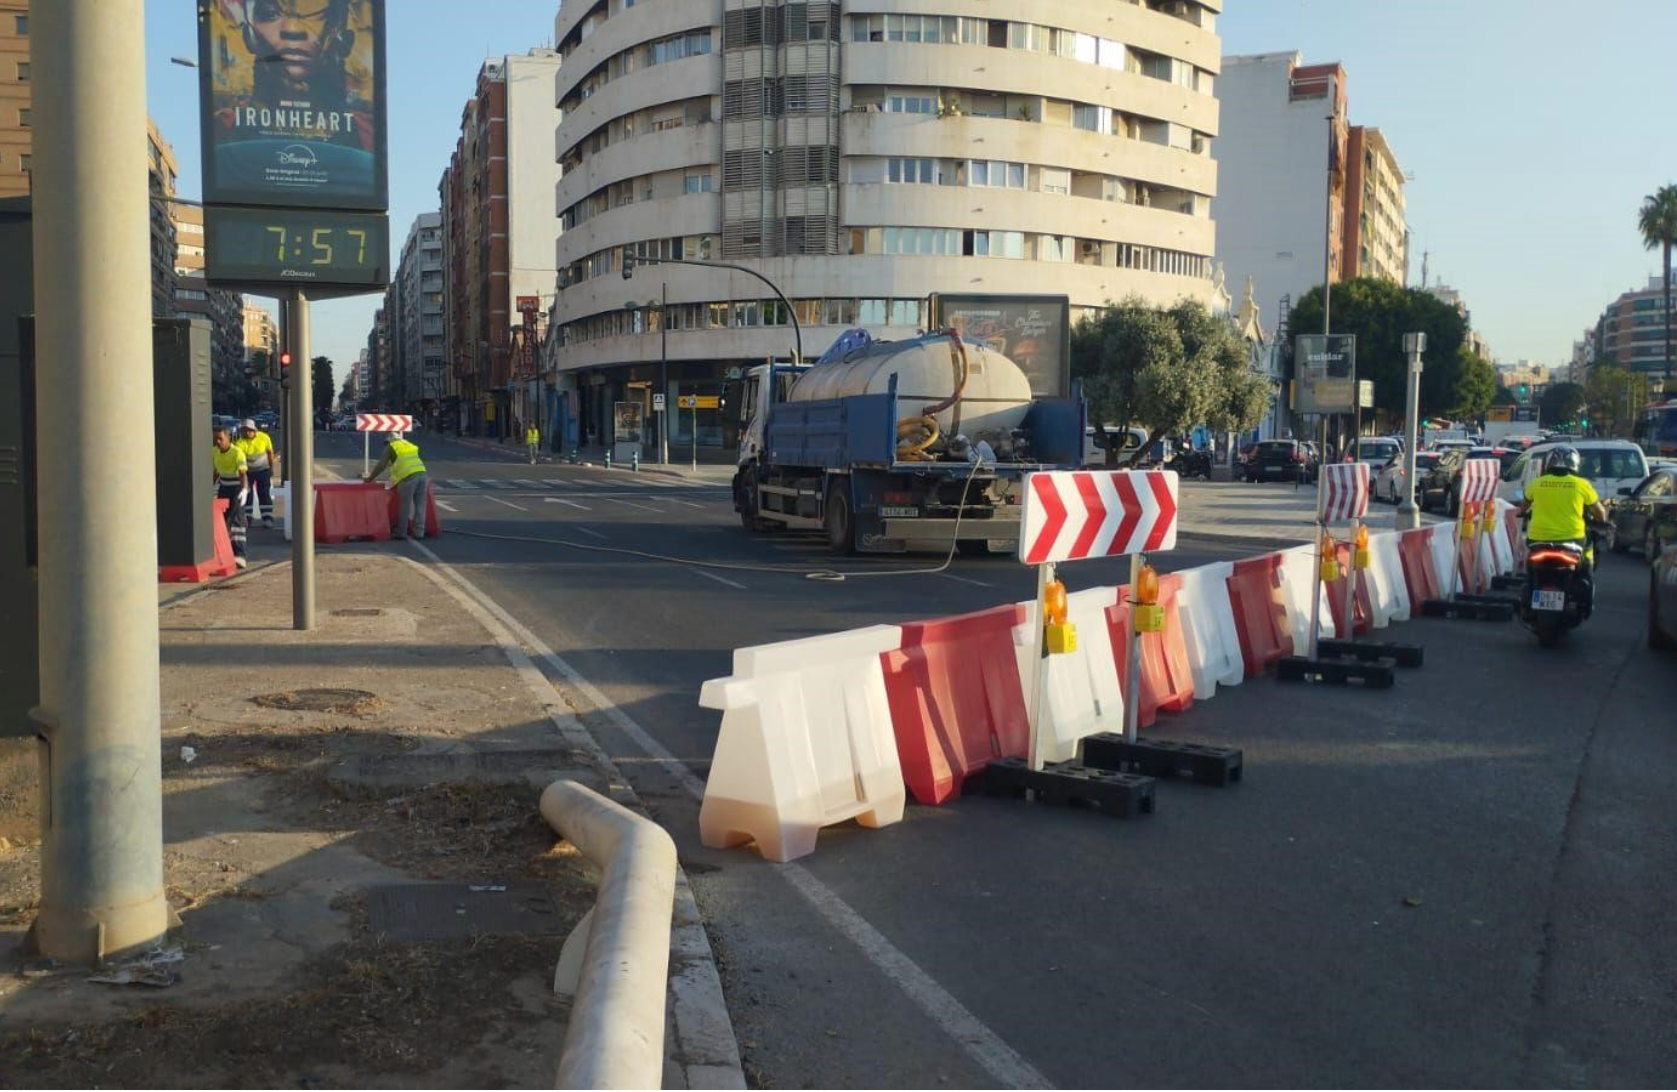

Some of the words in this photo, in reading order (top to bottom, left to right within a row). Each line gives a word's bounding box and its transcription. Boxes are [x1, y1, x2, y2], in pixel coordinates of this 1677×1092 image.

[235, 106, 354, 133] IRONHEART
[266, 226, 366, 265] 7:57
[1307, 351, 1344, 361] cuidar
